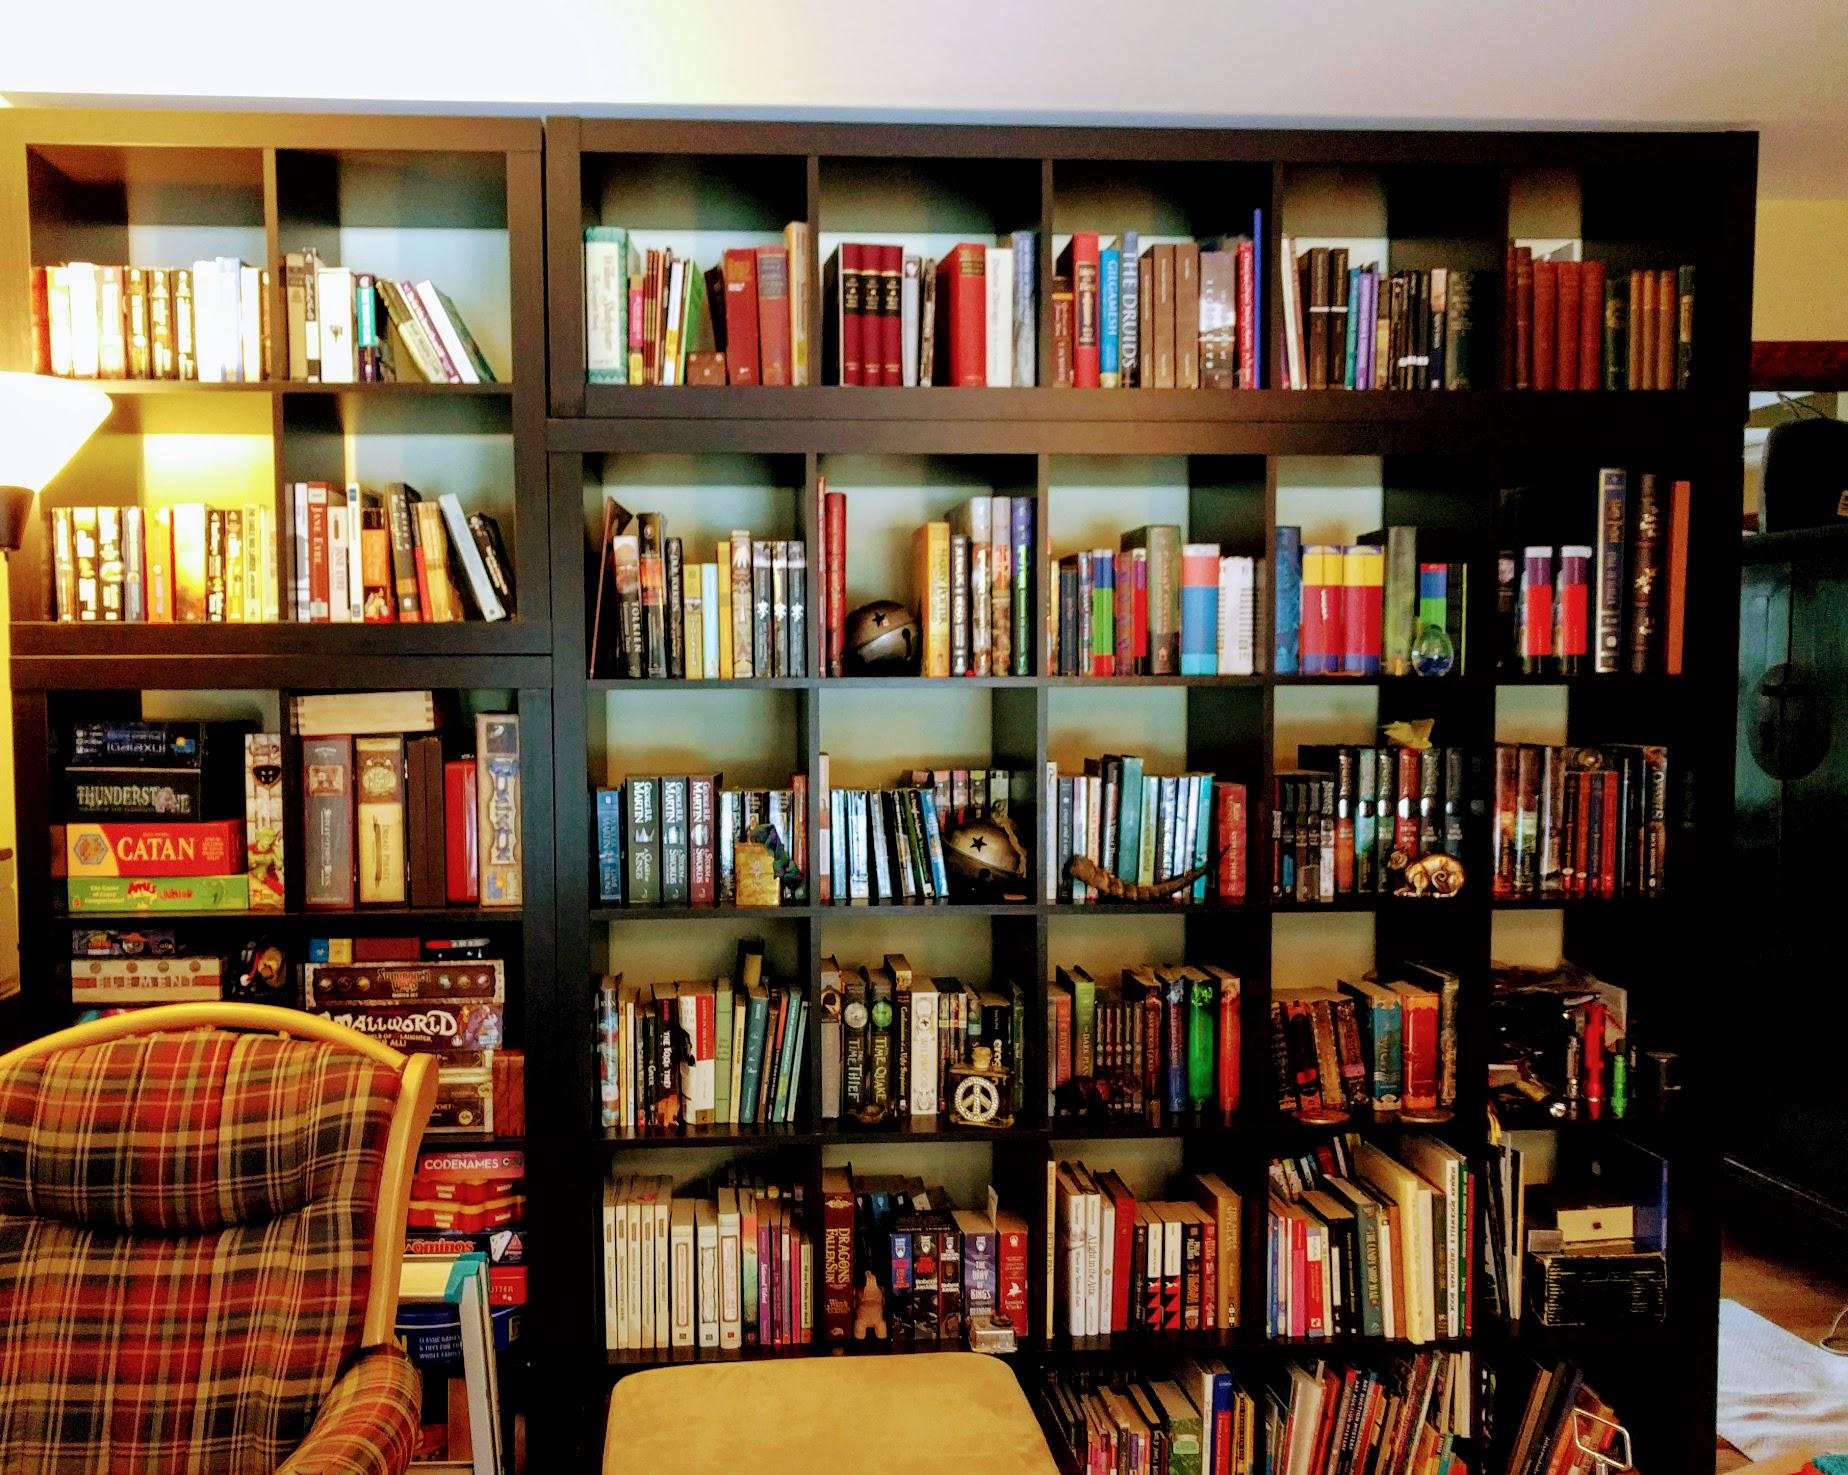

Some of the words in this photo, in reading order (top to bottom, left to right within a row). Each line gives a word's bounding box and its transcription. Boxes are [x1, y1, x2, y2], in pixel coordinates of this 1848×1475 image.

[1123, 253, 1138, 288] THE
[1107, 259, 1119, 336] GILGAMESH
[1123, 294, 1138, 369] DRUIDS
[310, 506, 325, 532] JANE
[311, 536, 325, 563] EYRE
[939, 549, 947, 583] HARRY
[938, 586, 948, 625] POTTER
[631, 602, 643, 653] TOLKIEN
[633, 782, 644, 824] MARTIN
[643, 782, 653, 808] GEORGE
[663, 782, 676, 823] MARTIN
[674, 782, 684, 808] GEORGE
[692, 782, 704, 823] MARTIN
[702, 782, 712, 808] GEORGE
[117, 837, 195, 862] CATAN
[634, 852, 645, 880] KINGS
[668, 850, 678, 885] SWORDS
[694, 848, 705, 884] SWORDS
[899, 1006, 909, 1041] Confessions
[662, 1031, 671, 1046] THE
[875, 1037, 888, 1064] TIME
[1081, 1033, 1091, 1053] DARK
[848, 1039, 860, 1065] TIME
[898, 1053, 909, 1065] Ugly
[648, 1065, 657, 1086] GIVER
[662, 1069, 672, 1089] THIEF
[847, 1064, 864, 1104] THIEF
[874, 1067, 888, 1104] QUAKE
[424, 1158, 498, 1171] CODENAMES
[825, 1228, 838, 1263] FALLEN
[1087, 1242, 1098, 1257] Light
[1365, 1232, 1377, 1243] THE
[838, 1227, 851, 1284] DRAGONS
[975, 1260, 986, 1270] THE
[1366, 1243, 1378, 1265] CANDY
[760, 1262, 769, 1287] National
[825, 1263, 838, 1283] SUN
[972, 1270, 989, 1281] WAY
[1088, 1268, 1097, 1279] the
[1367, 1266, 1379, 1283] SHOP
[1449, 1247, 1457, 1289] CHRISTMAS
[761, 1287, 769, 1305] Velvet
[970, 1289, 992, 1301] KINGS
[1087, 1279, 1098, 1297] Attic
[1369, 1284, 1379, 1300] WAR
[1347, 1393, 1358, 1423] AUCTION
[1354, 1392, 1367, 1422] AUCTION
[1341, 1423, 1352, 1452] MYSTERY
[1347, 1422, 1360, 1451] MYSTERY
